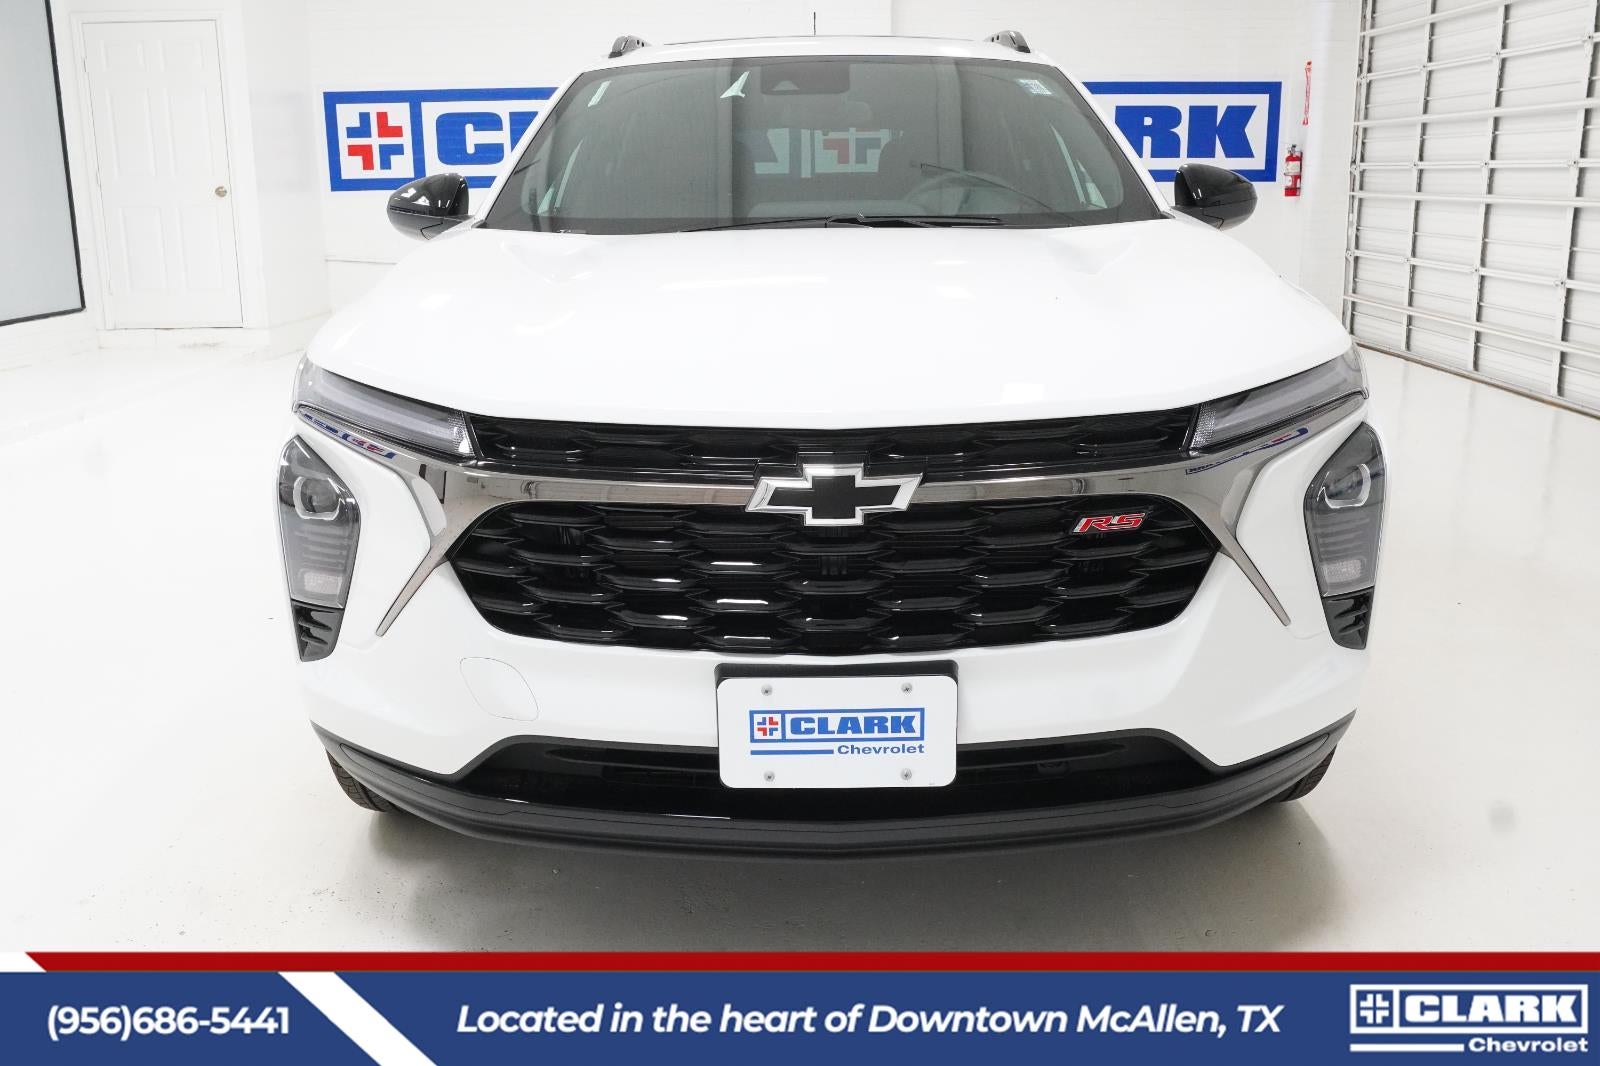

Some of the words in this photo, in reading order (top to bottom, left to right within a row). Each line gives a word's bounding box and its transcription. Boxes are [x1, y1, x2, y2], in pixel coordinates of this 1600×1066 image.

[1073, 513, 1146, 533] RS
[790, 715, 916, 735] CLARK
[837, 744, 925, 755] Chevrolet
